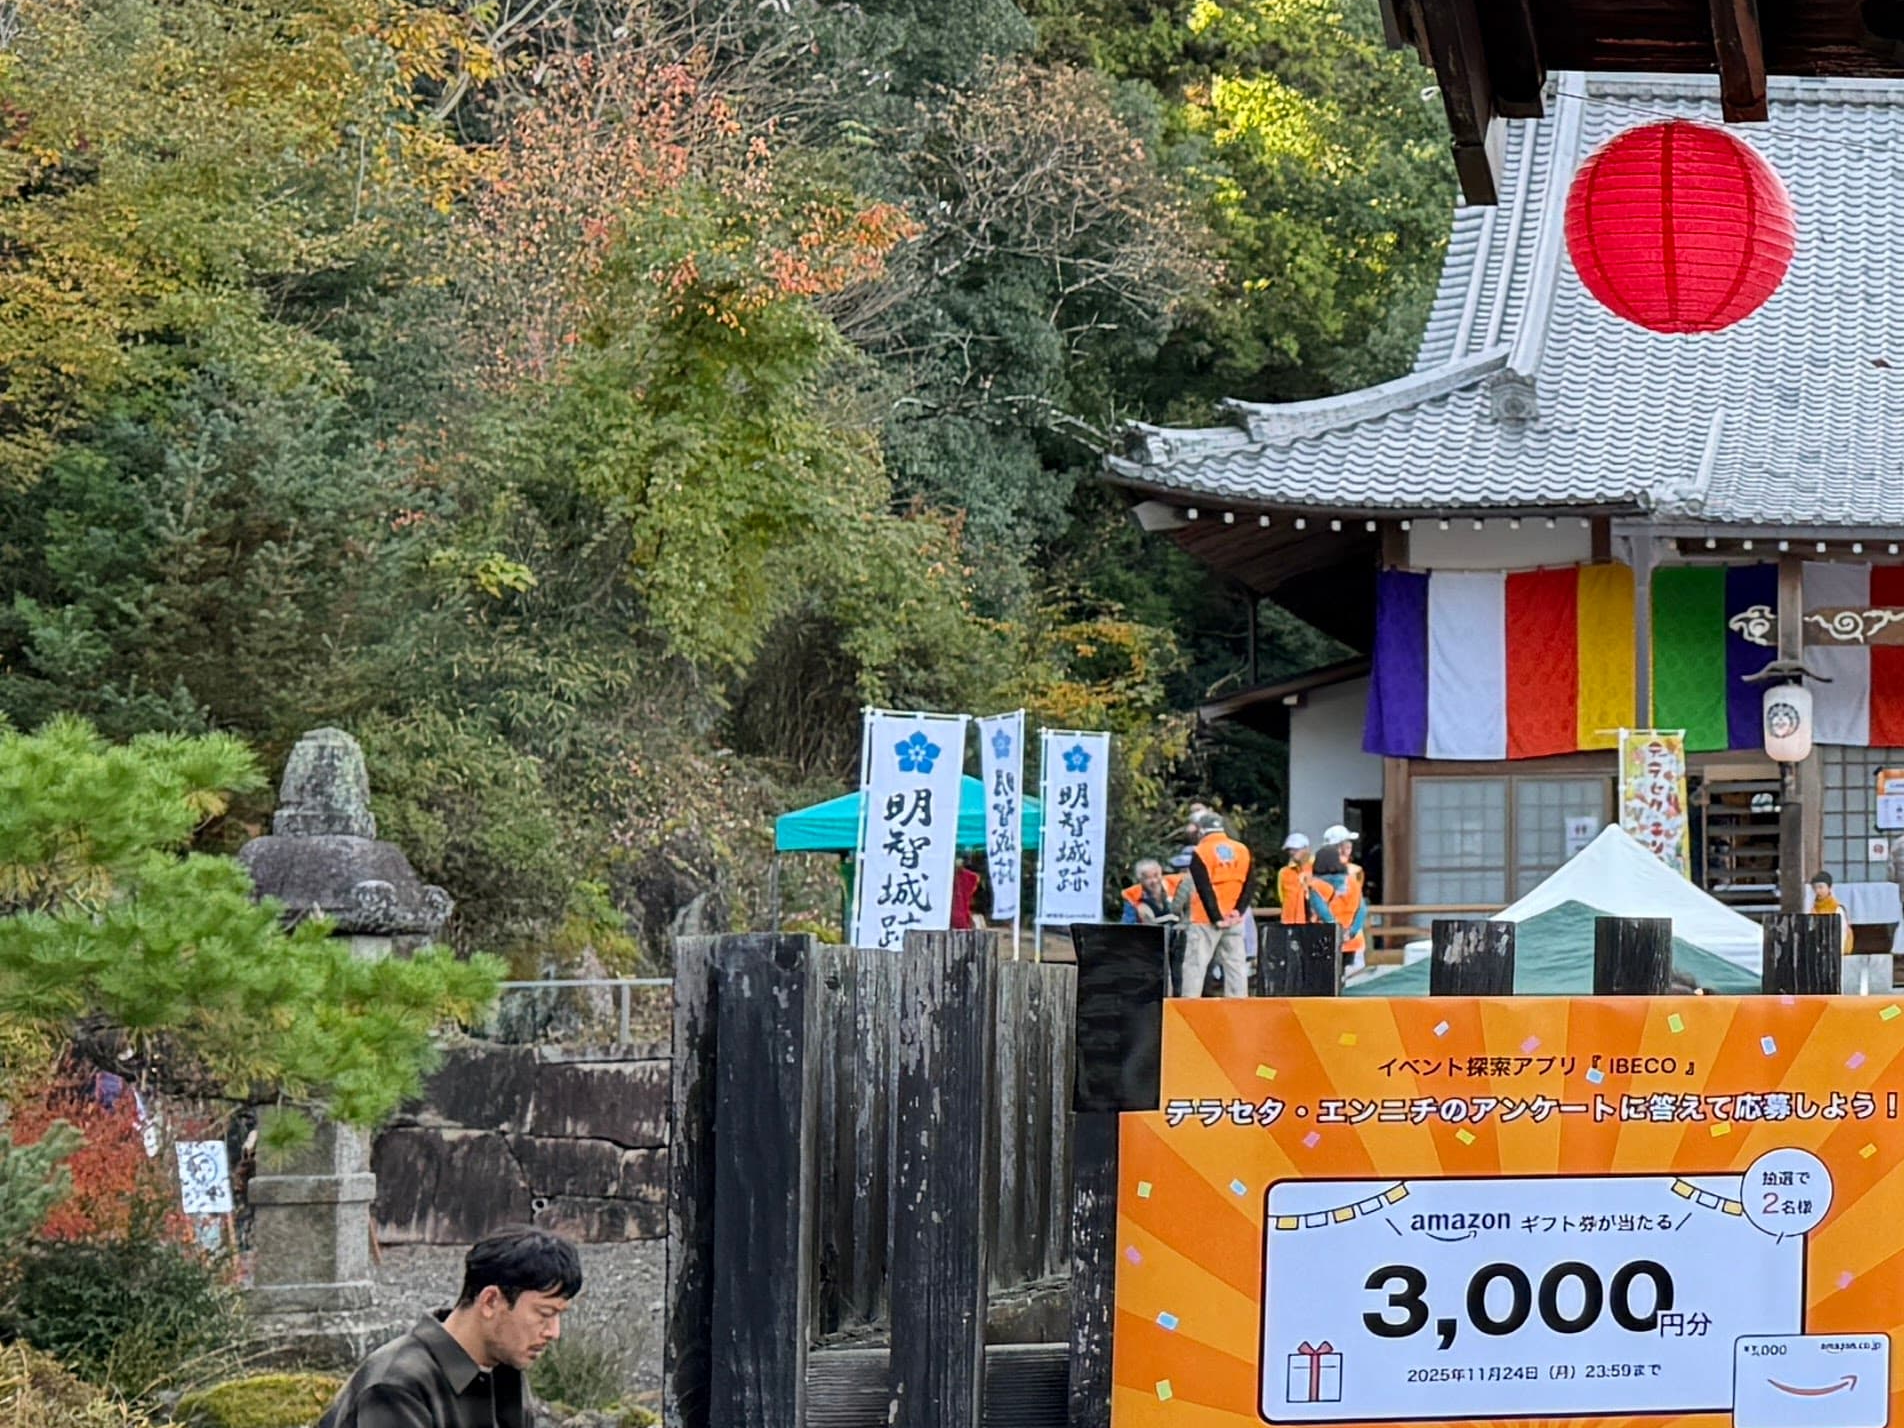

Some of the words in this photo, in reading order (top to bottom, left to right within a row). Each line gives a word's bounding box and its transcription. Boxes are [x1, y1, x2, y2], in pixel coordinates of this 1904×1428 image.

[1056, 782, 1092, 892] 明智城跡
[1165, 1091, 1899, 1128] テラセタ・エンニチのアンケートに答えて応募しよう！
[1762, 1171, 1810, 1186] 抽選で
[1762, 1192, 1812, 1215] 2名様
[1411, 1212, 1511, 1232] amazon
[1521, 1213, 1672, 1233] ギフト券が当たる
